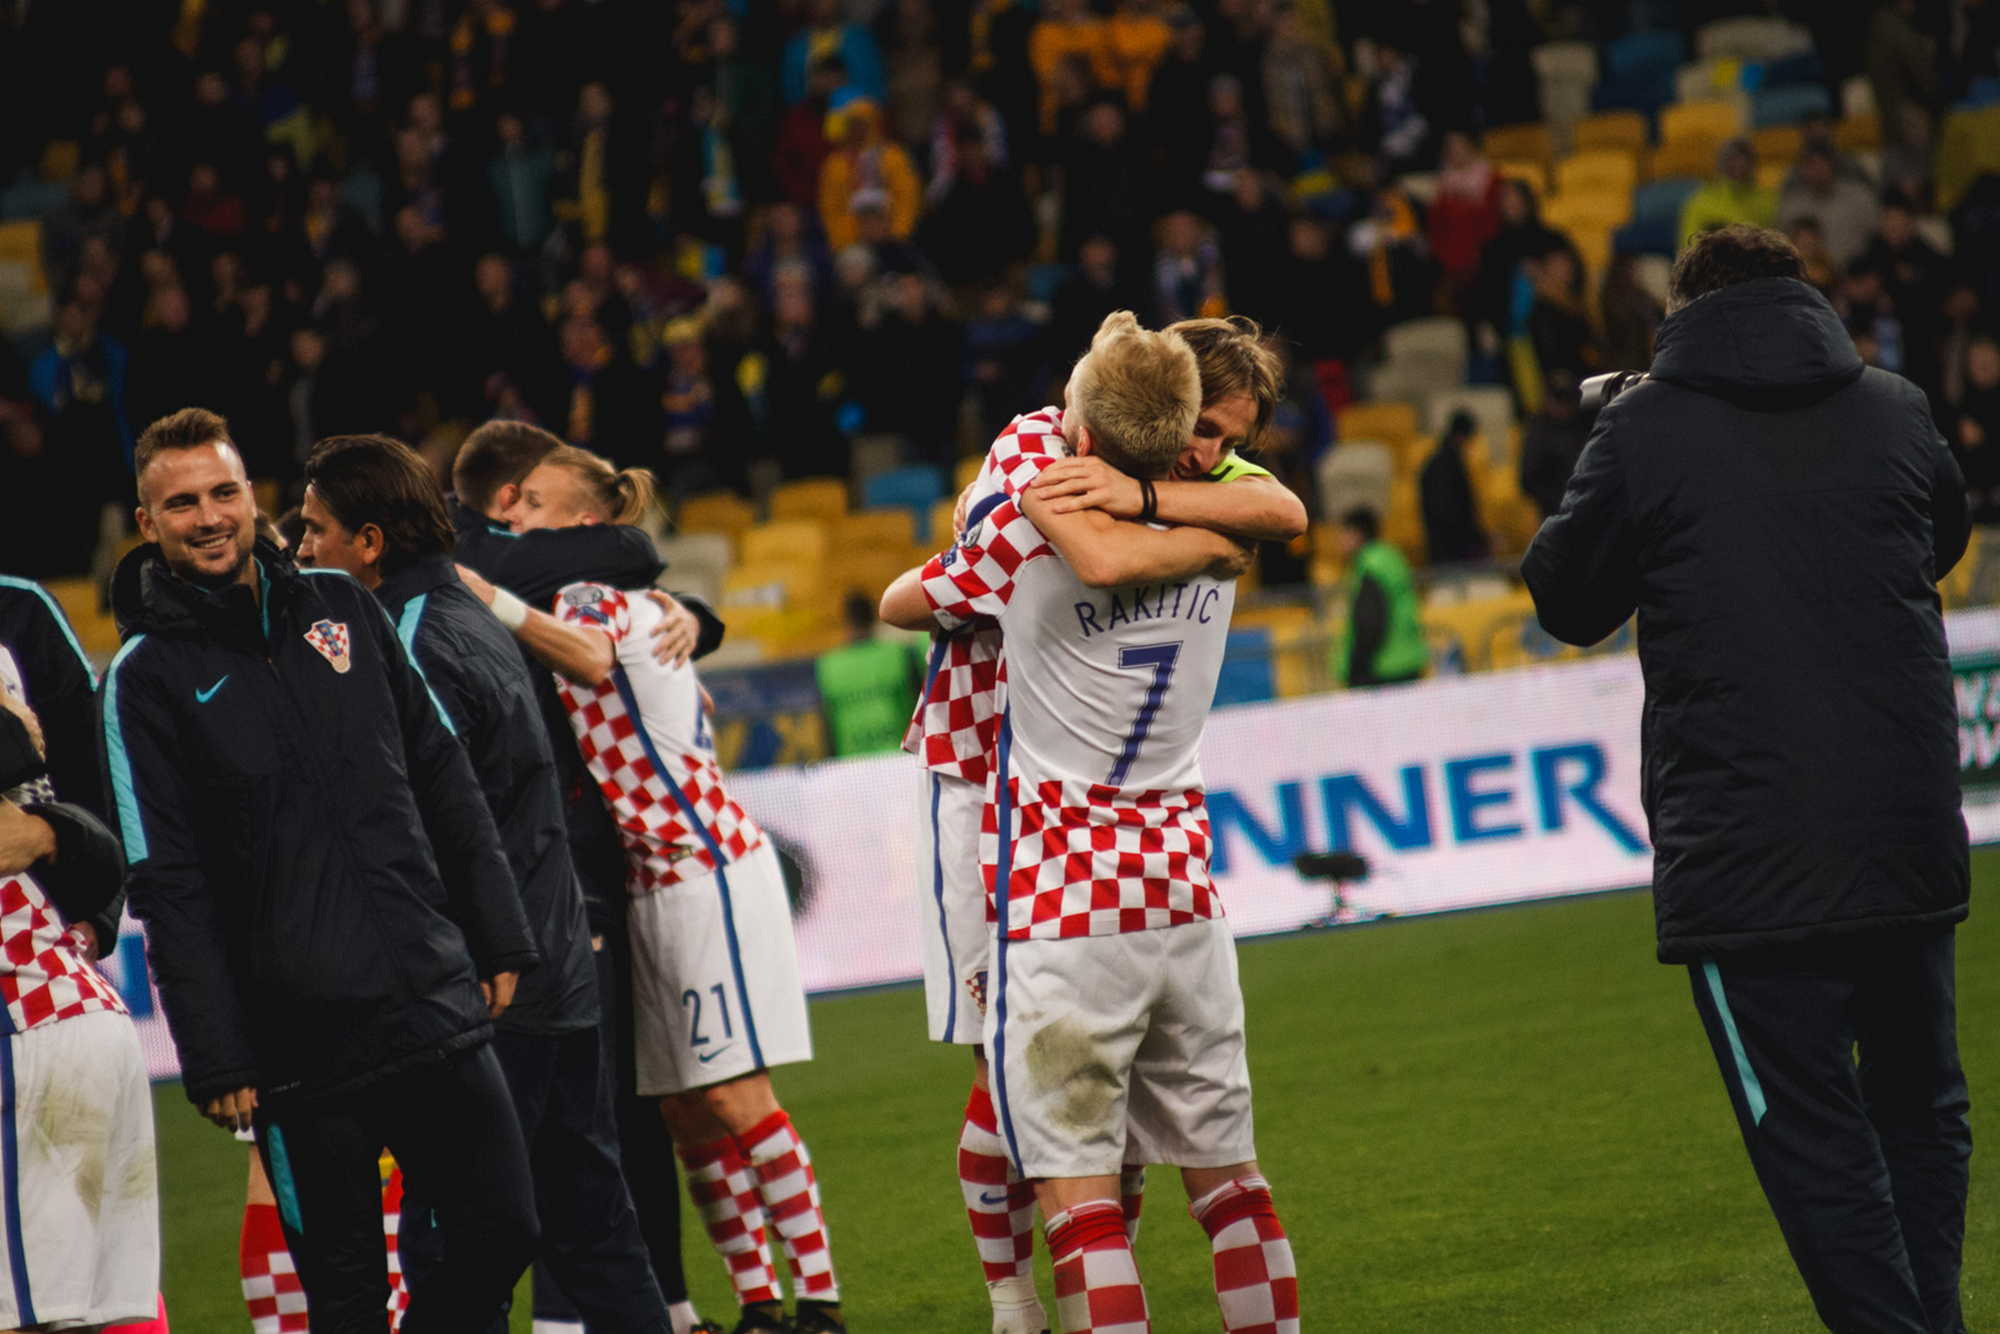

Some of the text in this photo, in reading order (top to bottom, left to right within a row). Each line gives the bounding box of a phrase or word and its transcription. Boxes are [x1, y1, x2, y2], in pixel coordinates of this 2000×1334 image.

[1103, 640, 1184, 787] 7
[1205, 741, 1652, 877] NNER
[682, 982, 733, 1047] 21
